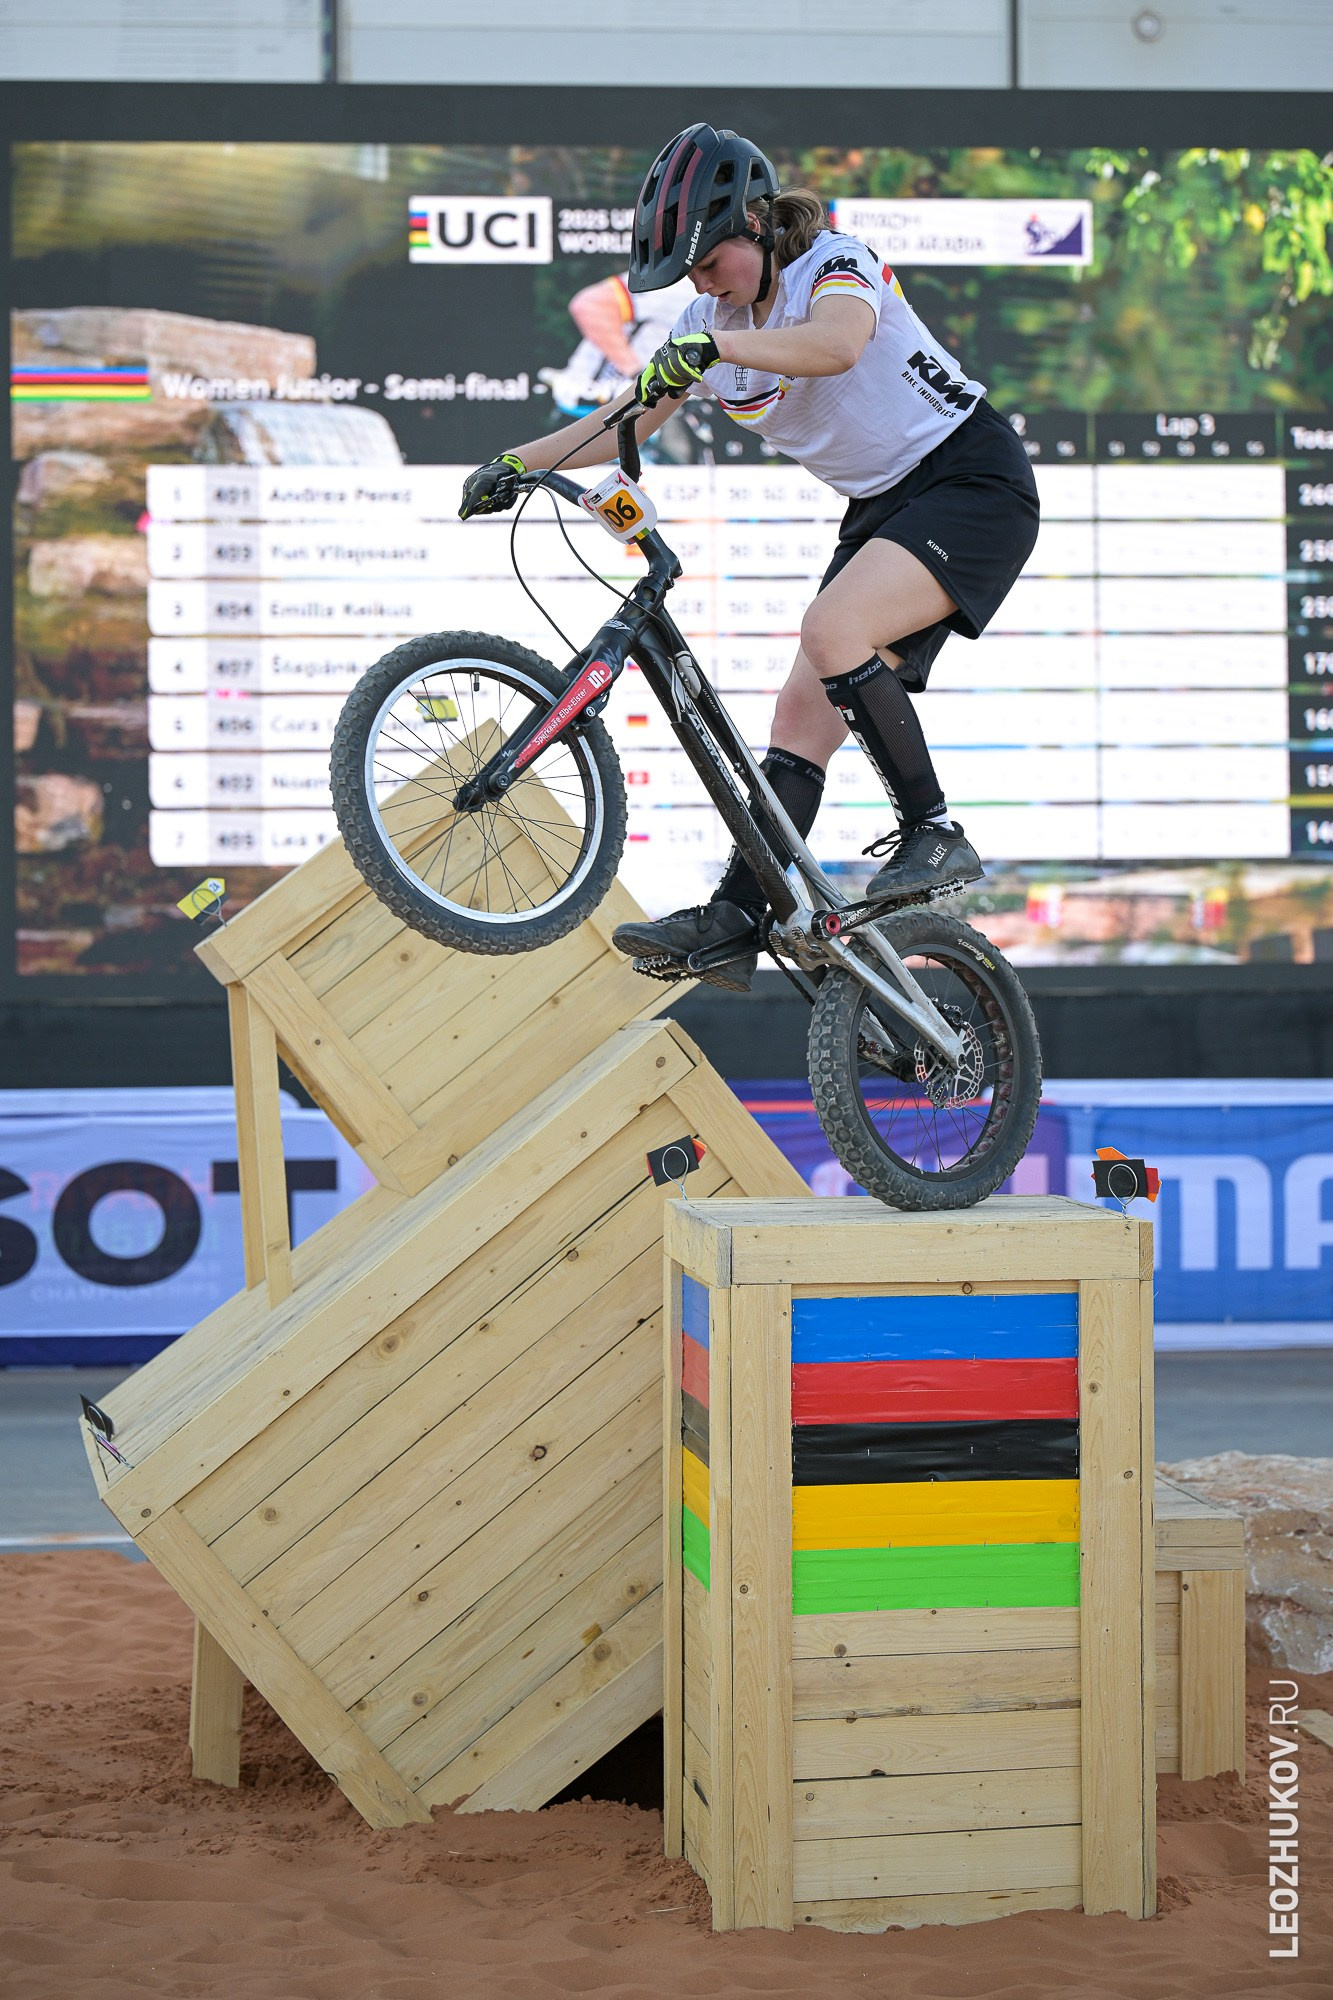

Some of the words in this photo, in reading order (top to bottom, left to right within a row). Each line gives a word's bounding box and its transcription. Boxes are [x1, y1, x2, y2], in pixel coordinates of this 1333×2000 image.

[438, 212, 536, 248] UCI
[685, 221, 702, 266] hebo
[161, 374, 271, 400] Women
[276, 373, 361, 400] Junior
[384, 372, 528, 400] Semi-final
[901, 371, 919, 388] BIKE
[917, 387, 956, 418] INDUSTRIES
[907, 351, 977, 411] KTM
[1156, 413, 1199, 439] Lap
[1199, 413, 1216, 437] 3
[1290, 426, 1333, 449] Tota
[603, 496, 637, 528] 06
[926, 539, 949, 562] KIPSTA
[848, 660, 882, 685] hebo
[702, 688, 719, 714] ULTIMATE
[533, 715, 562, 747] Sparkasse
